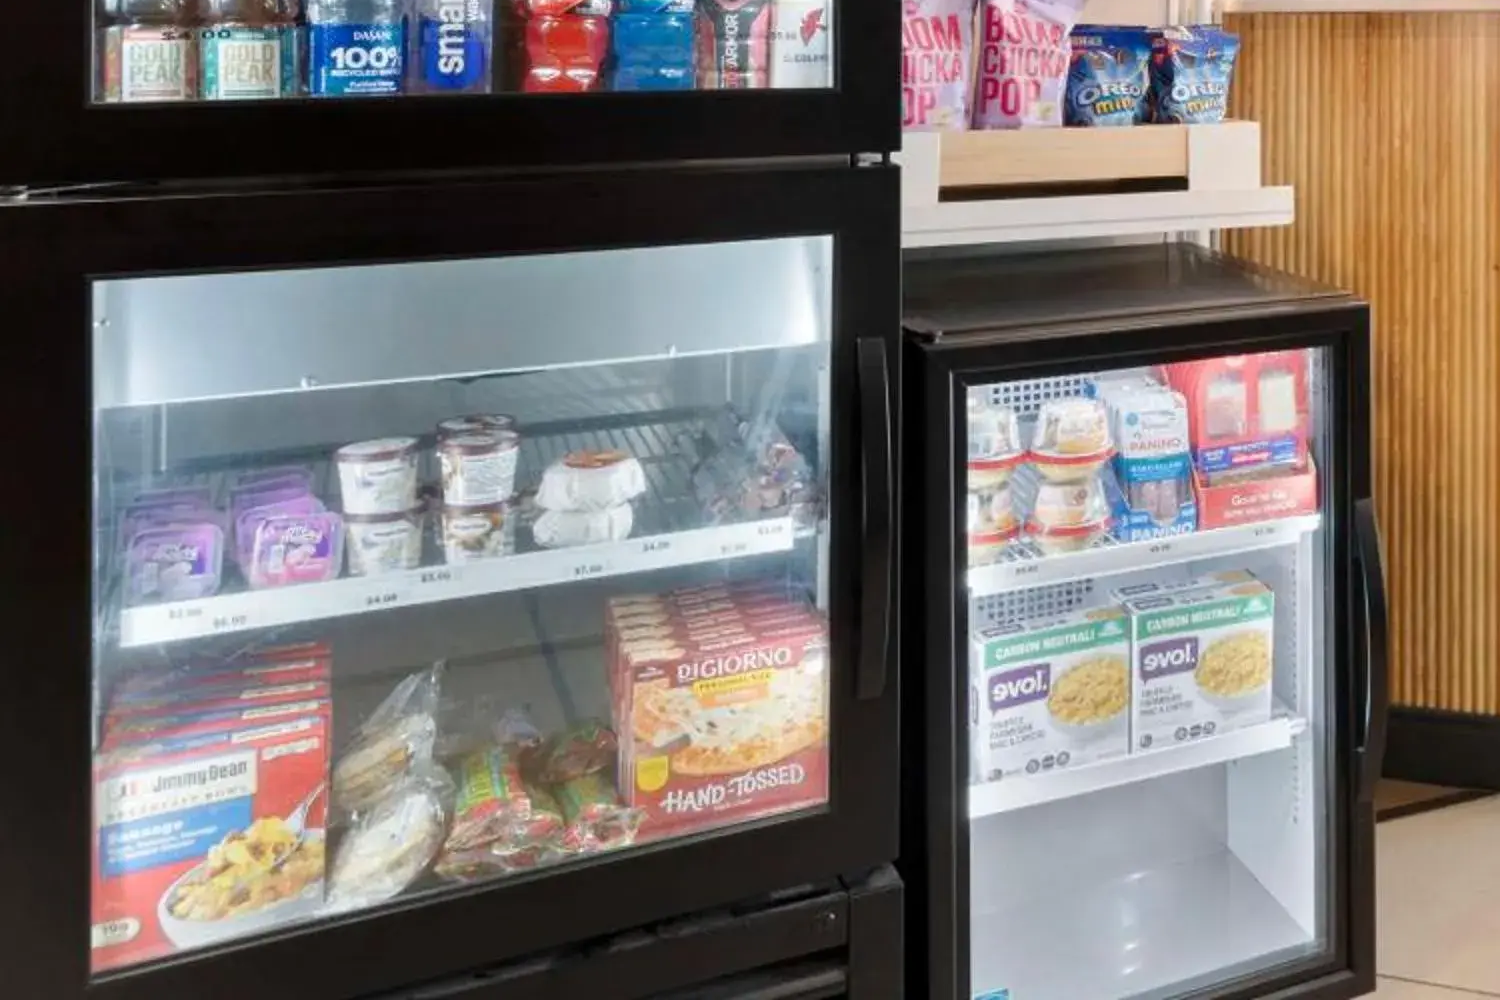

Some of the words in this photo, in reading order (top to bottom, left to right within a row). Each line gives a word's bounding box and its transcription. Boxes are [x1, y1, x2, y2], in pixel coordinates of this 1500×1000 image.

[129, 63, 182, 84] PEAK
[224, 63, 275, 84] PEAK
[981, 76, 1041, 118] POP
[1131, 521, 1194, 542] PANINO
[677, 646, 792, 682] DIGIORNO
[209, 760, 248, 781] Dean
